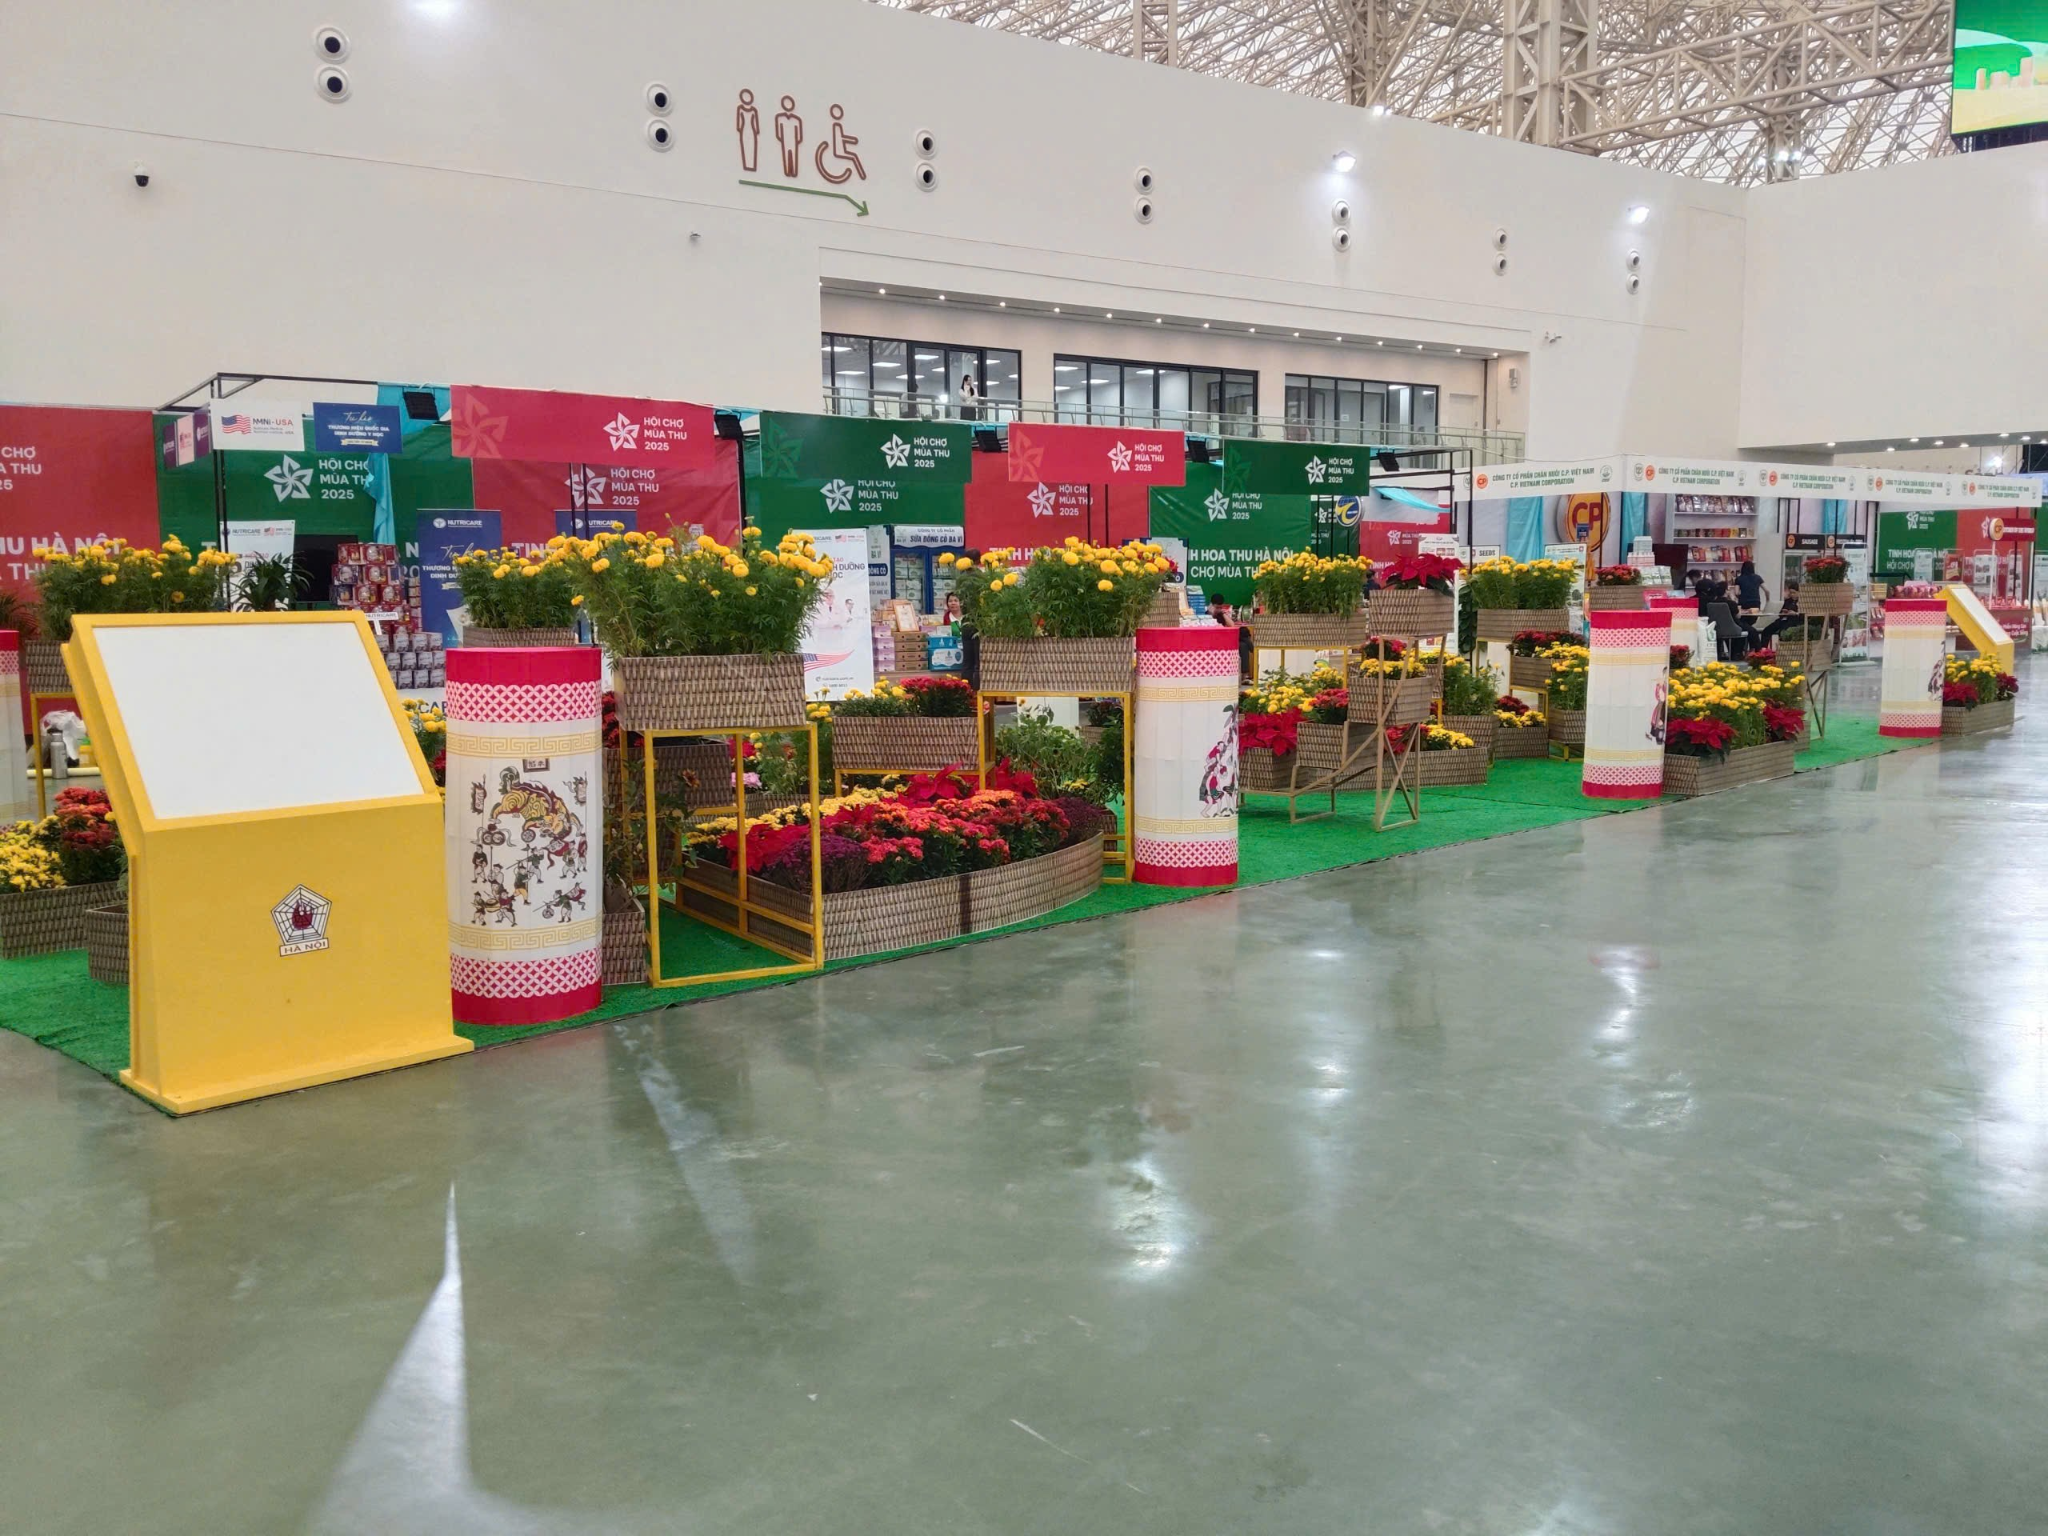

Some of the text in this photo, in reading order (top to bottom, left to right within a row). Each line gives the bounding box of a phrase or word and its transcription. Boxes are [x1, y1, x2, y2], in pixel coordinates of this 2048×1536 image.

[643, 416, 685, 429] HỘI CHỢ
[643, 428, 688, 440] MÙA THU
[644, 441, 670, 451] 2025
[913, 436, 948, 449] HỘI CHỢ
[1134, 443, 1163, 453] HỘI CHỢ
[913, 447, 950, 458] MÙA THU
[1134, 453, 1165, 462] MÙA THU
[318, 457, 342, 472] HỘI
[914, 459, 935, 468] 2025
[1328, 457, 1353, 467] HỘI CHỢ
[10, 463, 42, 475] THU
[610, 466, 656, 480] HỘI CHỢ
[1134, 464, 1152, 472] 2025
[1328, 466, 1355, 475] MÙA THU
[319, 471, 350, 485] MÙA
[1328, 476, 1344, 484] 2025
[611, 480, 660, 493] MÙA THU
[1058, 484, 1073, 494] HỘI
[321, 488, 355, 500] 2025
[858, 489, 899, 500] MÙA THU
[1059, 494, 1076, 505] MÙA
[612, 496, 640, 505] 2025
[1232, 500, 1263, 510] MÙA THU
[858, 502, 882, 511] 2025
[1059, 508, 1079, 516] 2025
[1232, 511, 1250, 520] 2025
[1572, 502, 1602, 532] CP
[31, 532, 69, 555] HÀ
[1200, 549, 1227, 562] HOA
[1229, 549, 1253, 562] THU
[1254, 546, 1272, 561] HÀ
[1478, 549, 1496, 557] SEEDS
[1190, 563, 1216, 581] CHỢ
[1217, 562, 1242, 578] MÙA
